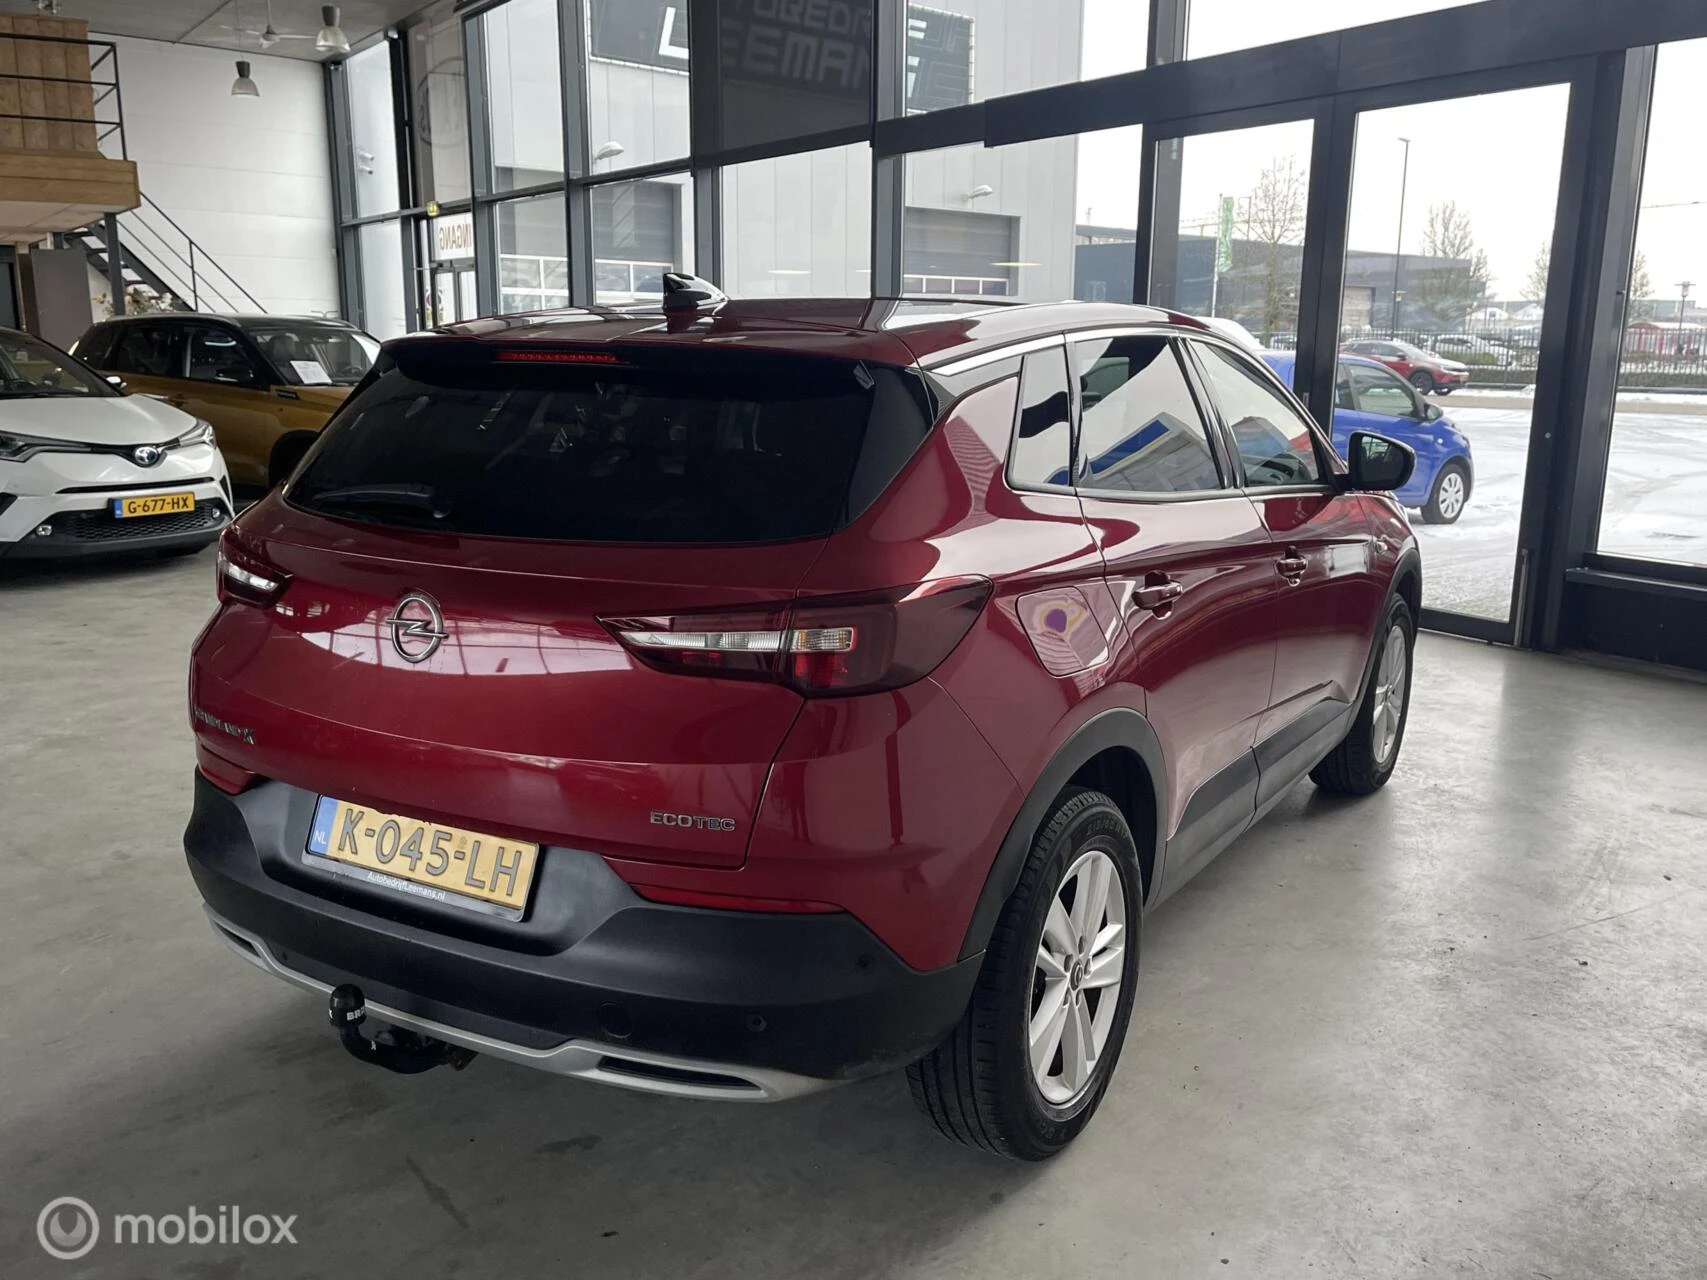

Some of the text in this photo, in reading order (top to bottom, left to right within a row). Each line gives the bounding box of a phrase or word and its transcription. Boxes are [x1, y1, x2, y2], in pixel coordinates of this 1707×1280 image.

[127, 496, 190, 514] G-677-HX
[650, 811, 735, 832] ECOTEC
[314, 829, 327, 844] NL
[338, 807, 522, 897] K-045-LH
